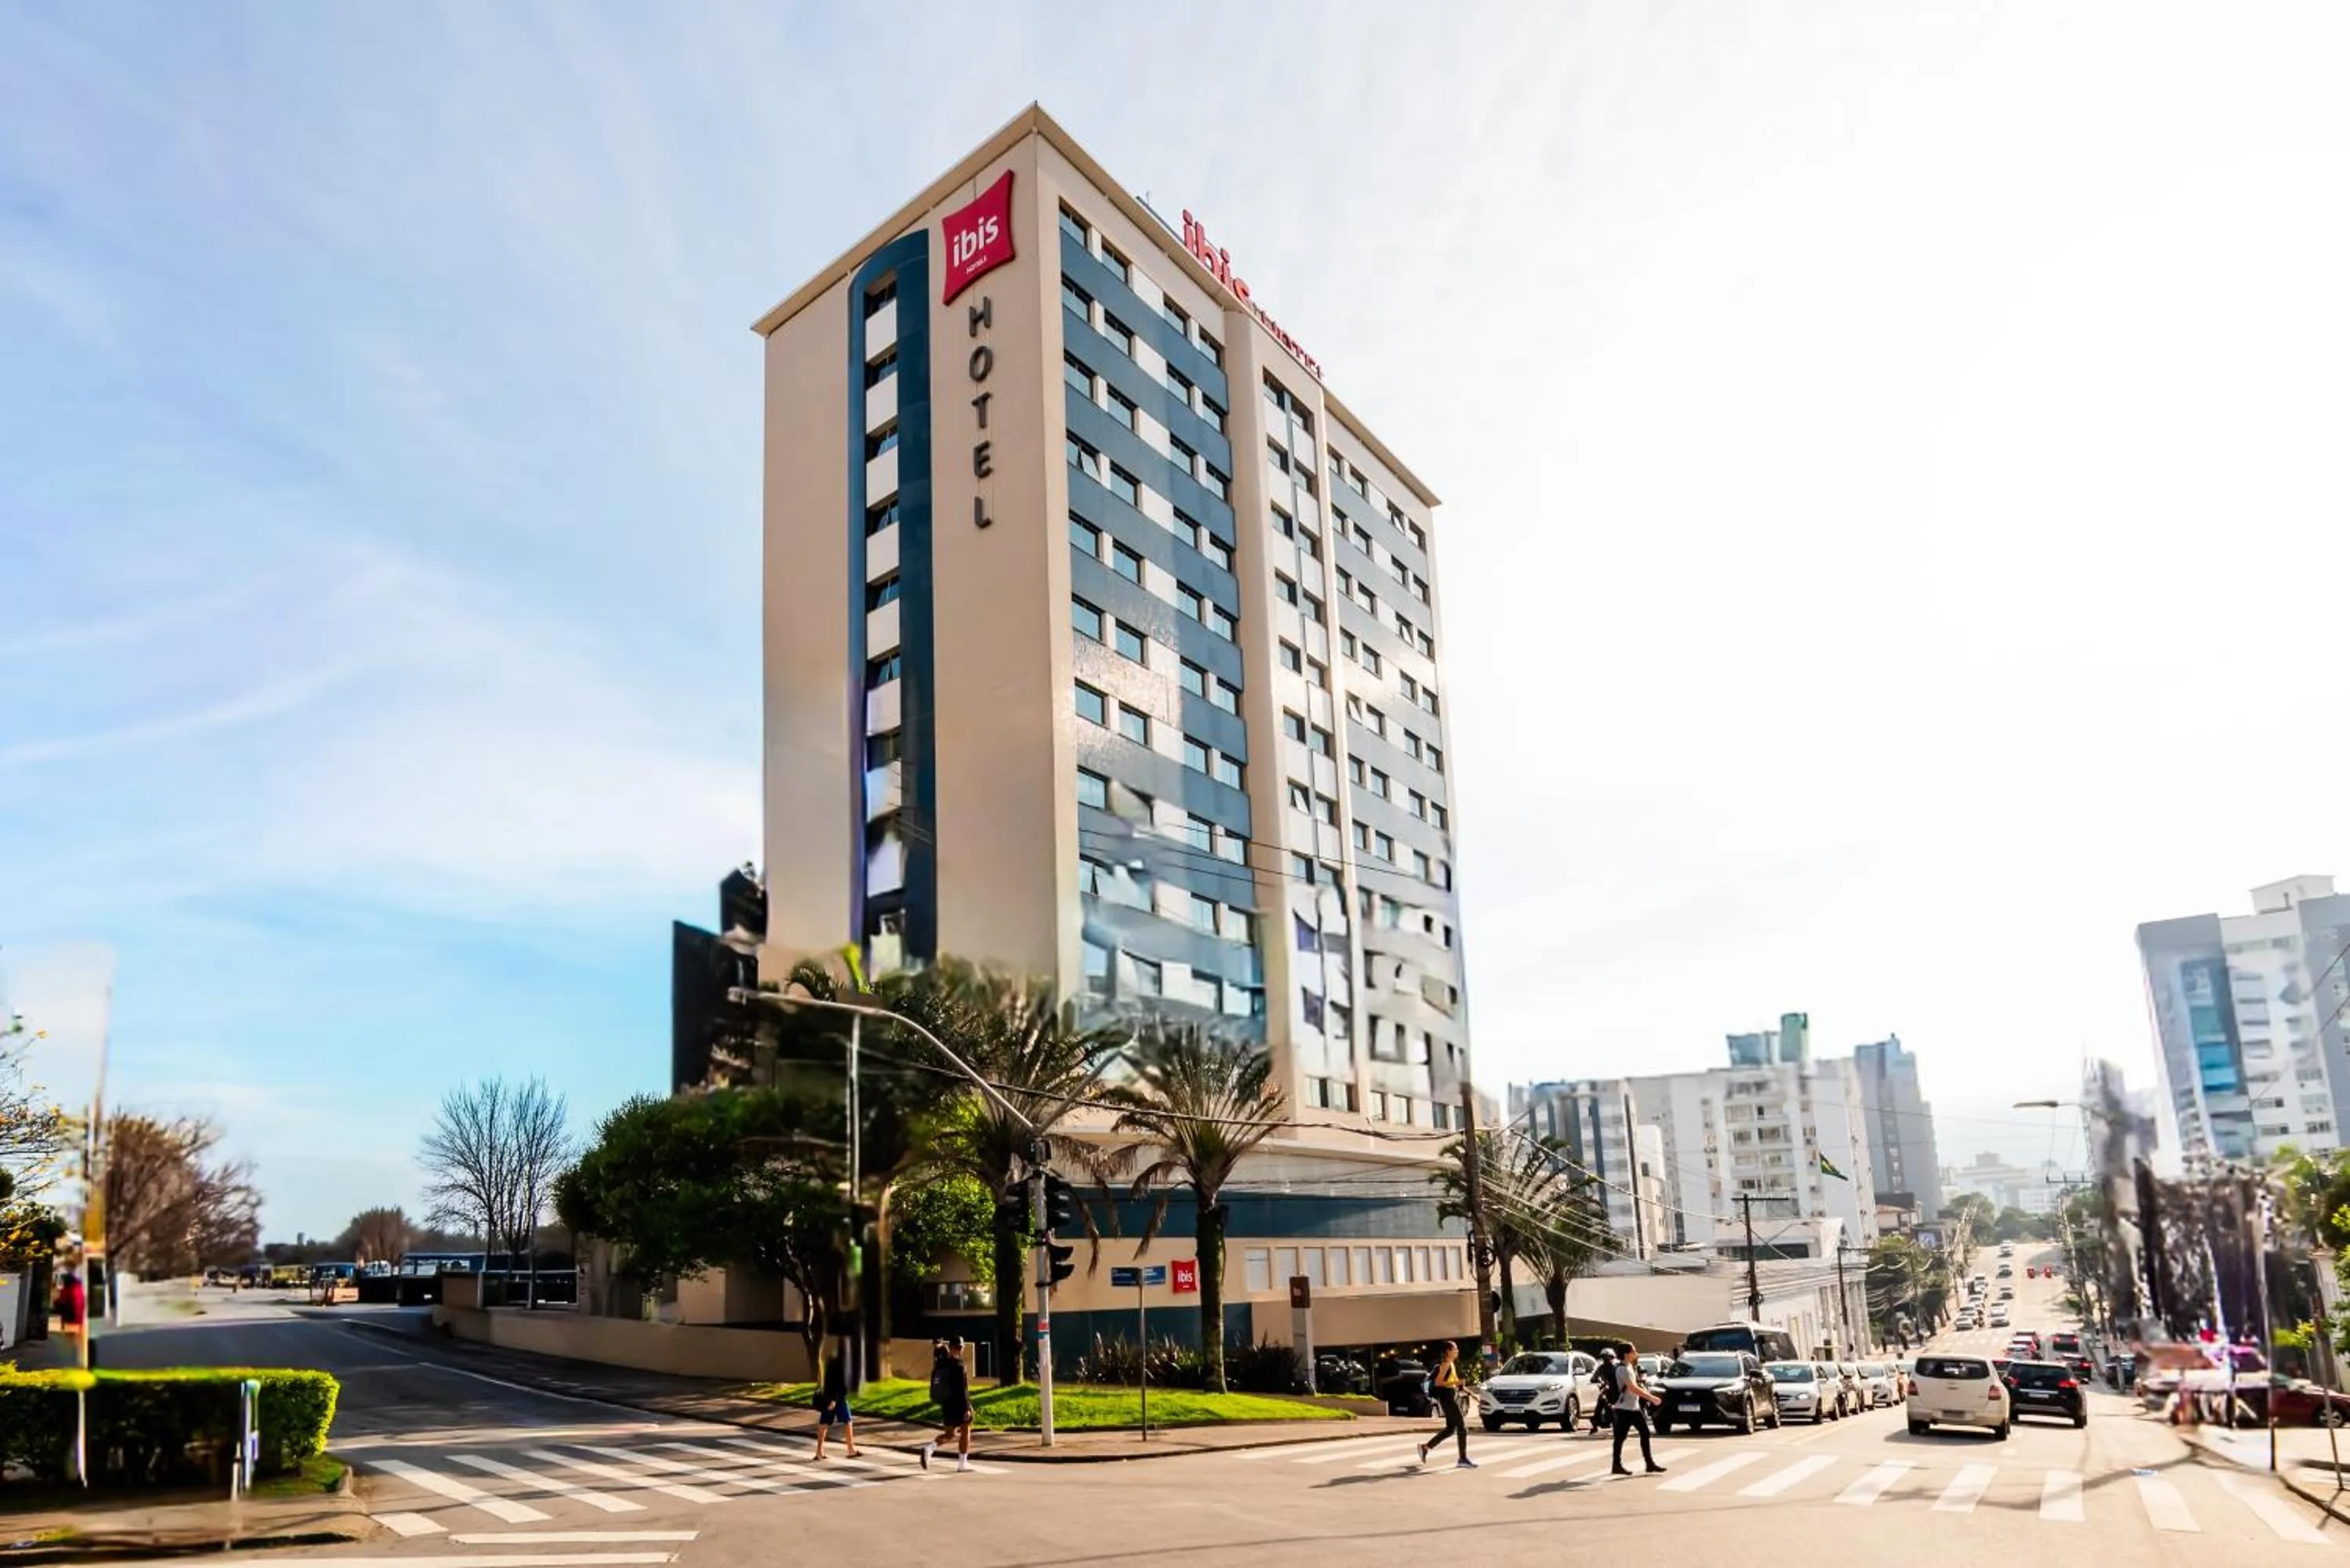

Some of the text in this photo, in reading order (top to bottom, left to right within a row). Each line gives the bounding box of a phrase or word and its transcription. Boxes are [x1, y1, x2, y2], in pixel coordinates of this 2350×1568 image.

[953, 215, 999, 267] ibis
[968, 296, 994, 529] HOTEL
[1177, 1270, 1193, 1283] ibis
